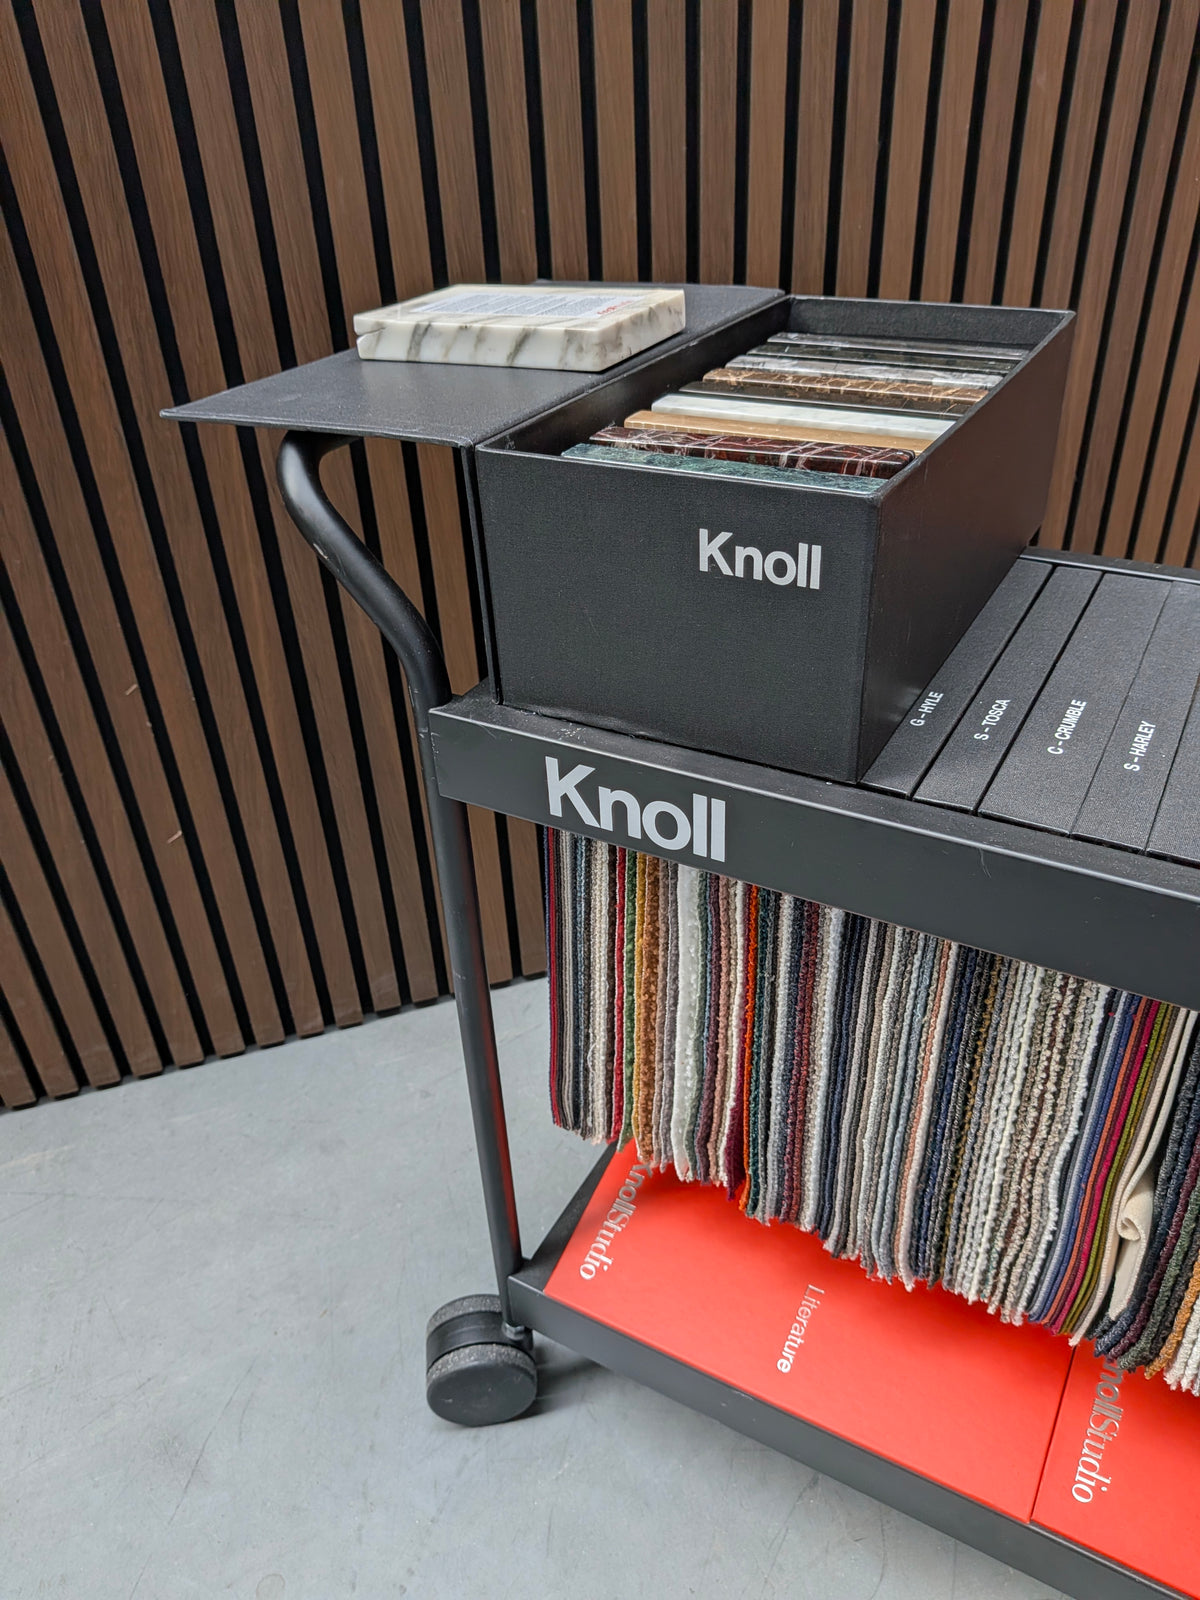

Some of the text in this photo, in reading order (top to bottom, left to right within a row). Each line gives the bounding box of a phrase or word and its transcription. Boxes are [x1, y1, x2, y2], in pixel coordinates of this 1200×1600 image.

[699, 528, 822, 590] Knoll
[909, 718, 926, 727] G
[918, 691, 945, 714] HYLE
[981, 699, 1012, 726] TOSCA
[1054, 699, 1088, 740] CRUMBLE
[973, 732, 990, 741] S
[1046, 746, 1064, 755] C
[1128, 720, 1157, 757] HARLEY
[1123, 762, 1141, 772] S
[545, 756, 726, 863] Knoll
[776, 1284, 825, 1374] Literature
[1071, 1361, 1124, 1504] nollStudio
